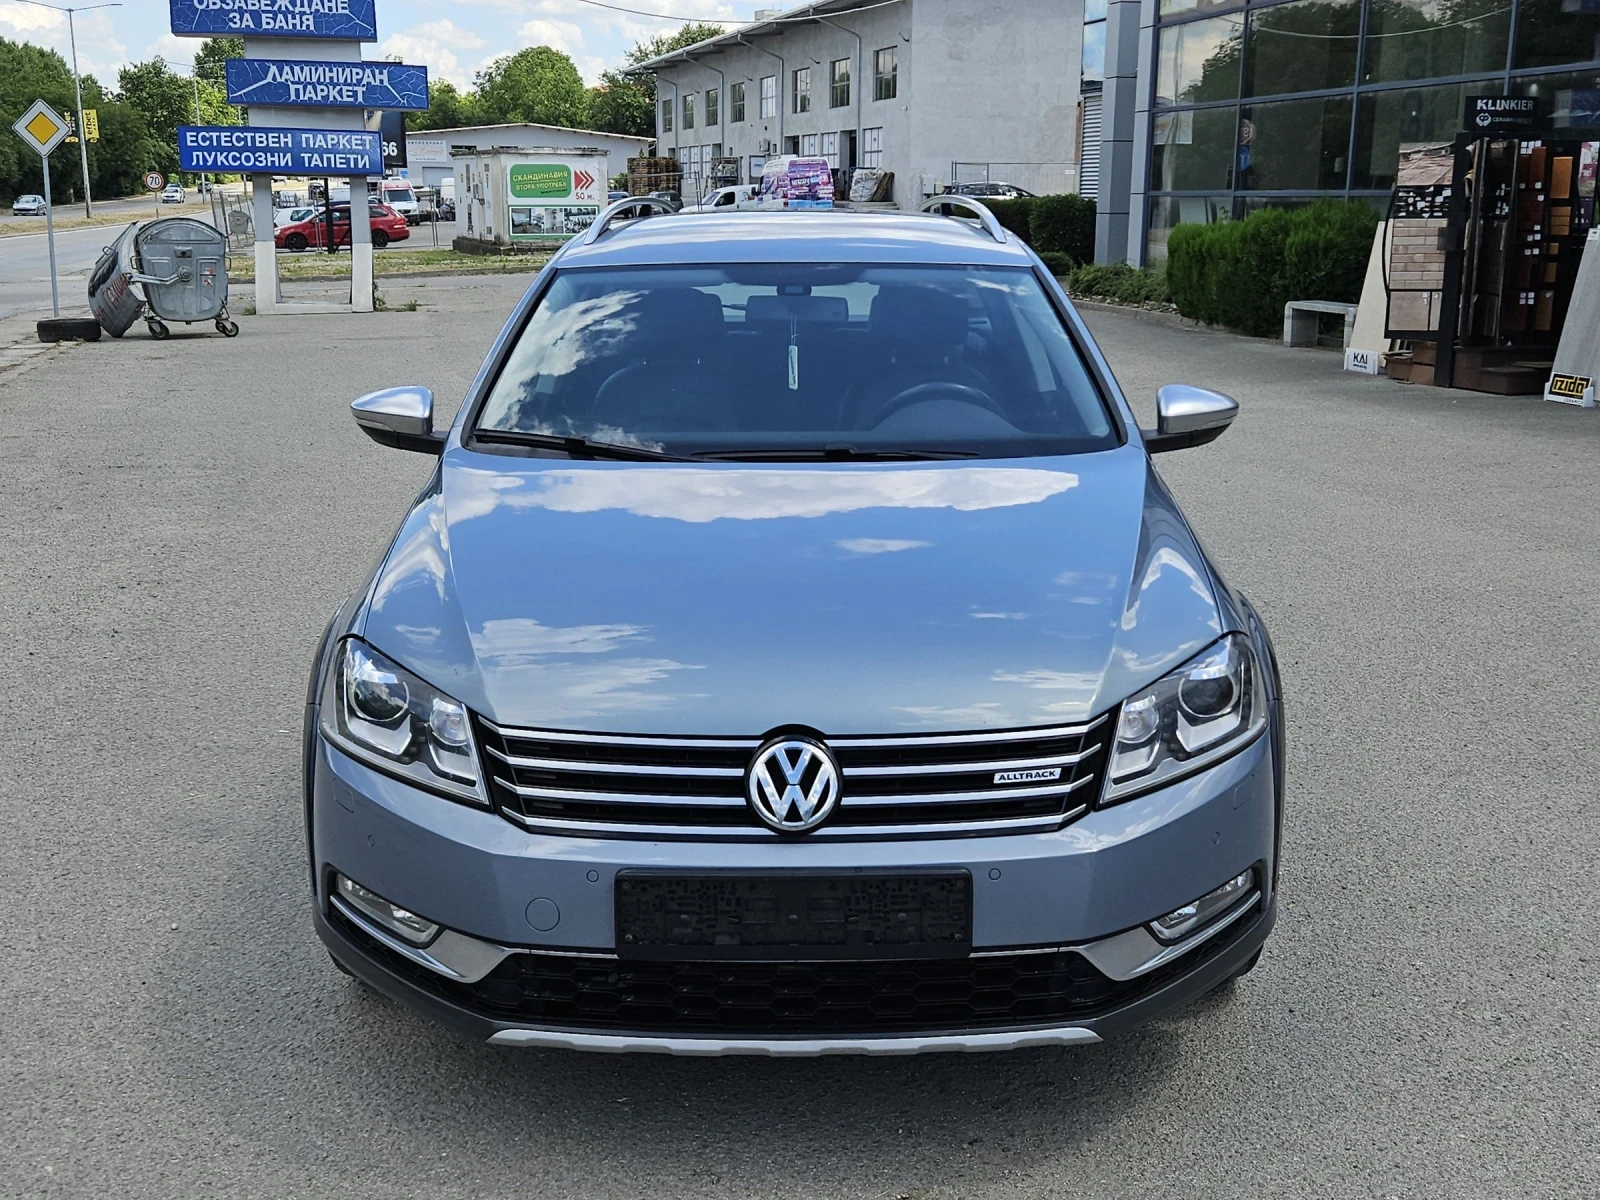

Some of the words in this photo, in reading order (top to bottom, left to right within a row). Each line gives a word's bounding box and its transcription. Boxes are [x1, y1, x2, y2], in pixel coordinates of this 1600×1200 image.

[193, 0, 349, 14] ОБЗАВЕЖДАНЕ
[229, 12, 253, 29] ЗА
[261, 13, 314, 31] БАНЯ
[267, 66, 388, 86] ЛАМИНИРАН
[289, 84, 366, 102] ПАРКЕТ
[1476, 99, 1534, 111] KLINKIER
[186, 131, 292, 148] ЕСТЕСТВЕН
[301, 134, 372, 150] ПАРКЕТ
[191, 151, 292, 168] ЛУКСОЗНИ
[301, 153, 370, 169] ТАПЕТИ
[149, 176, 160, 186] 70
[512, 170, 568, 182] СКАНДИНАВИЯ
[516, 183, 535, 191] ВТОРА
[536, 181, 567, 190] УПОТРЕБА
[575, 192, 585, 200] 50
[1353, 352, 1368, 365] KAI
[998, 769, 1056, 781] ALLTRACK
